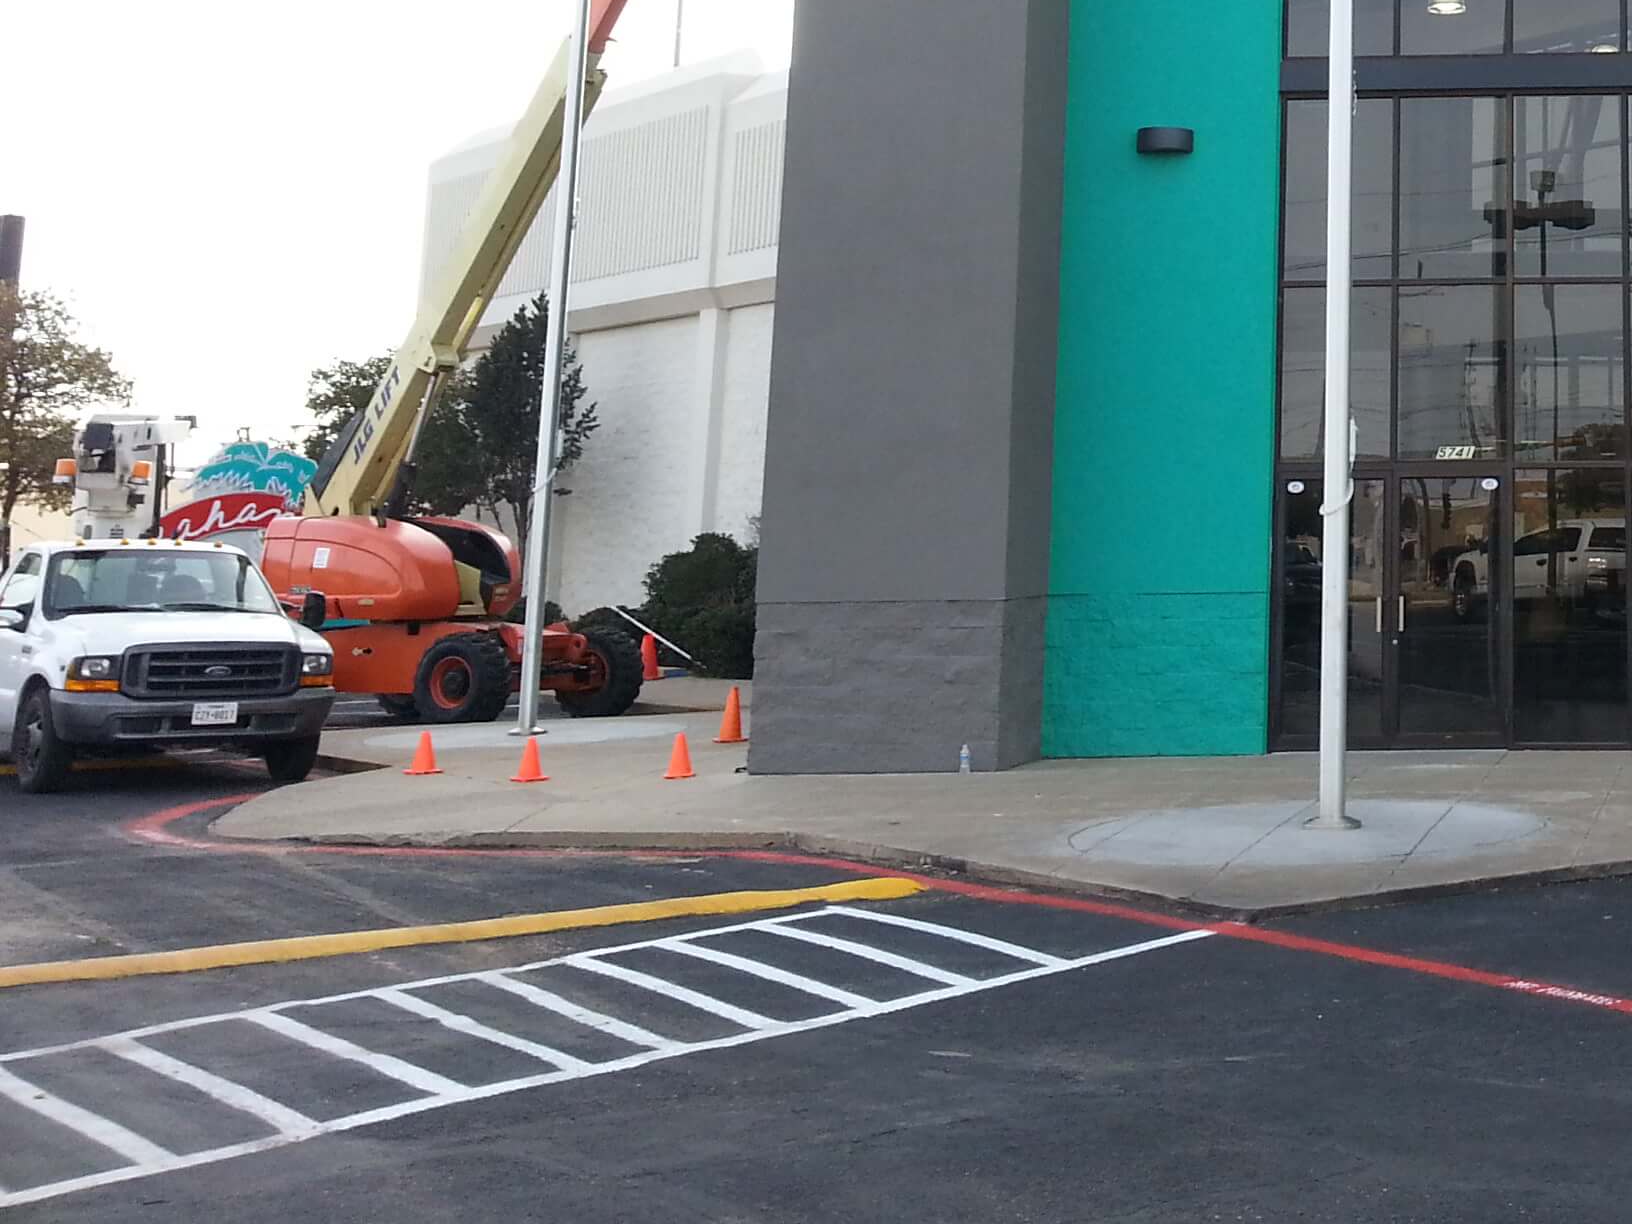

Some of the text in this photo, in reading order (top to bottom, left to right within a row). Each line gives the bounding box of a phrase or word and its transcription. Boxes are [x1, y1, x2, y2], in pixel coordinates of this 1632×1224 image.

[353, 364, 400, 464] JLG LIFT
[1439, 447, 1471, 458] 5741
